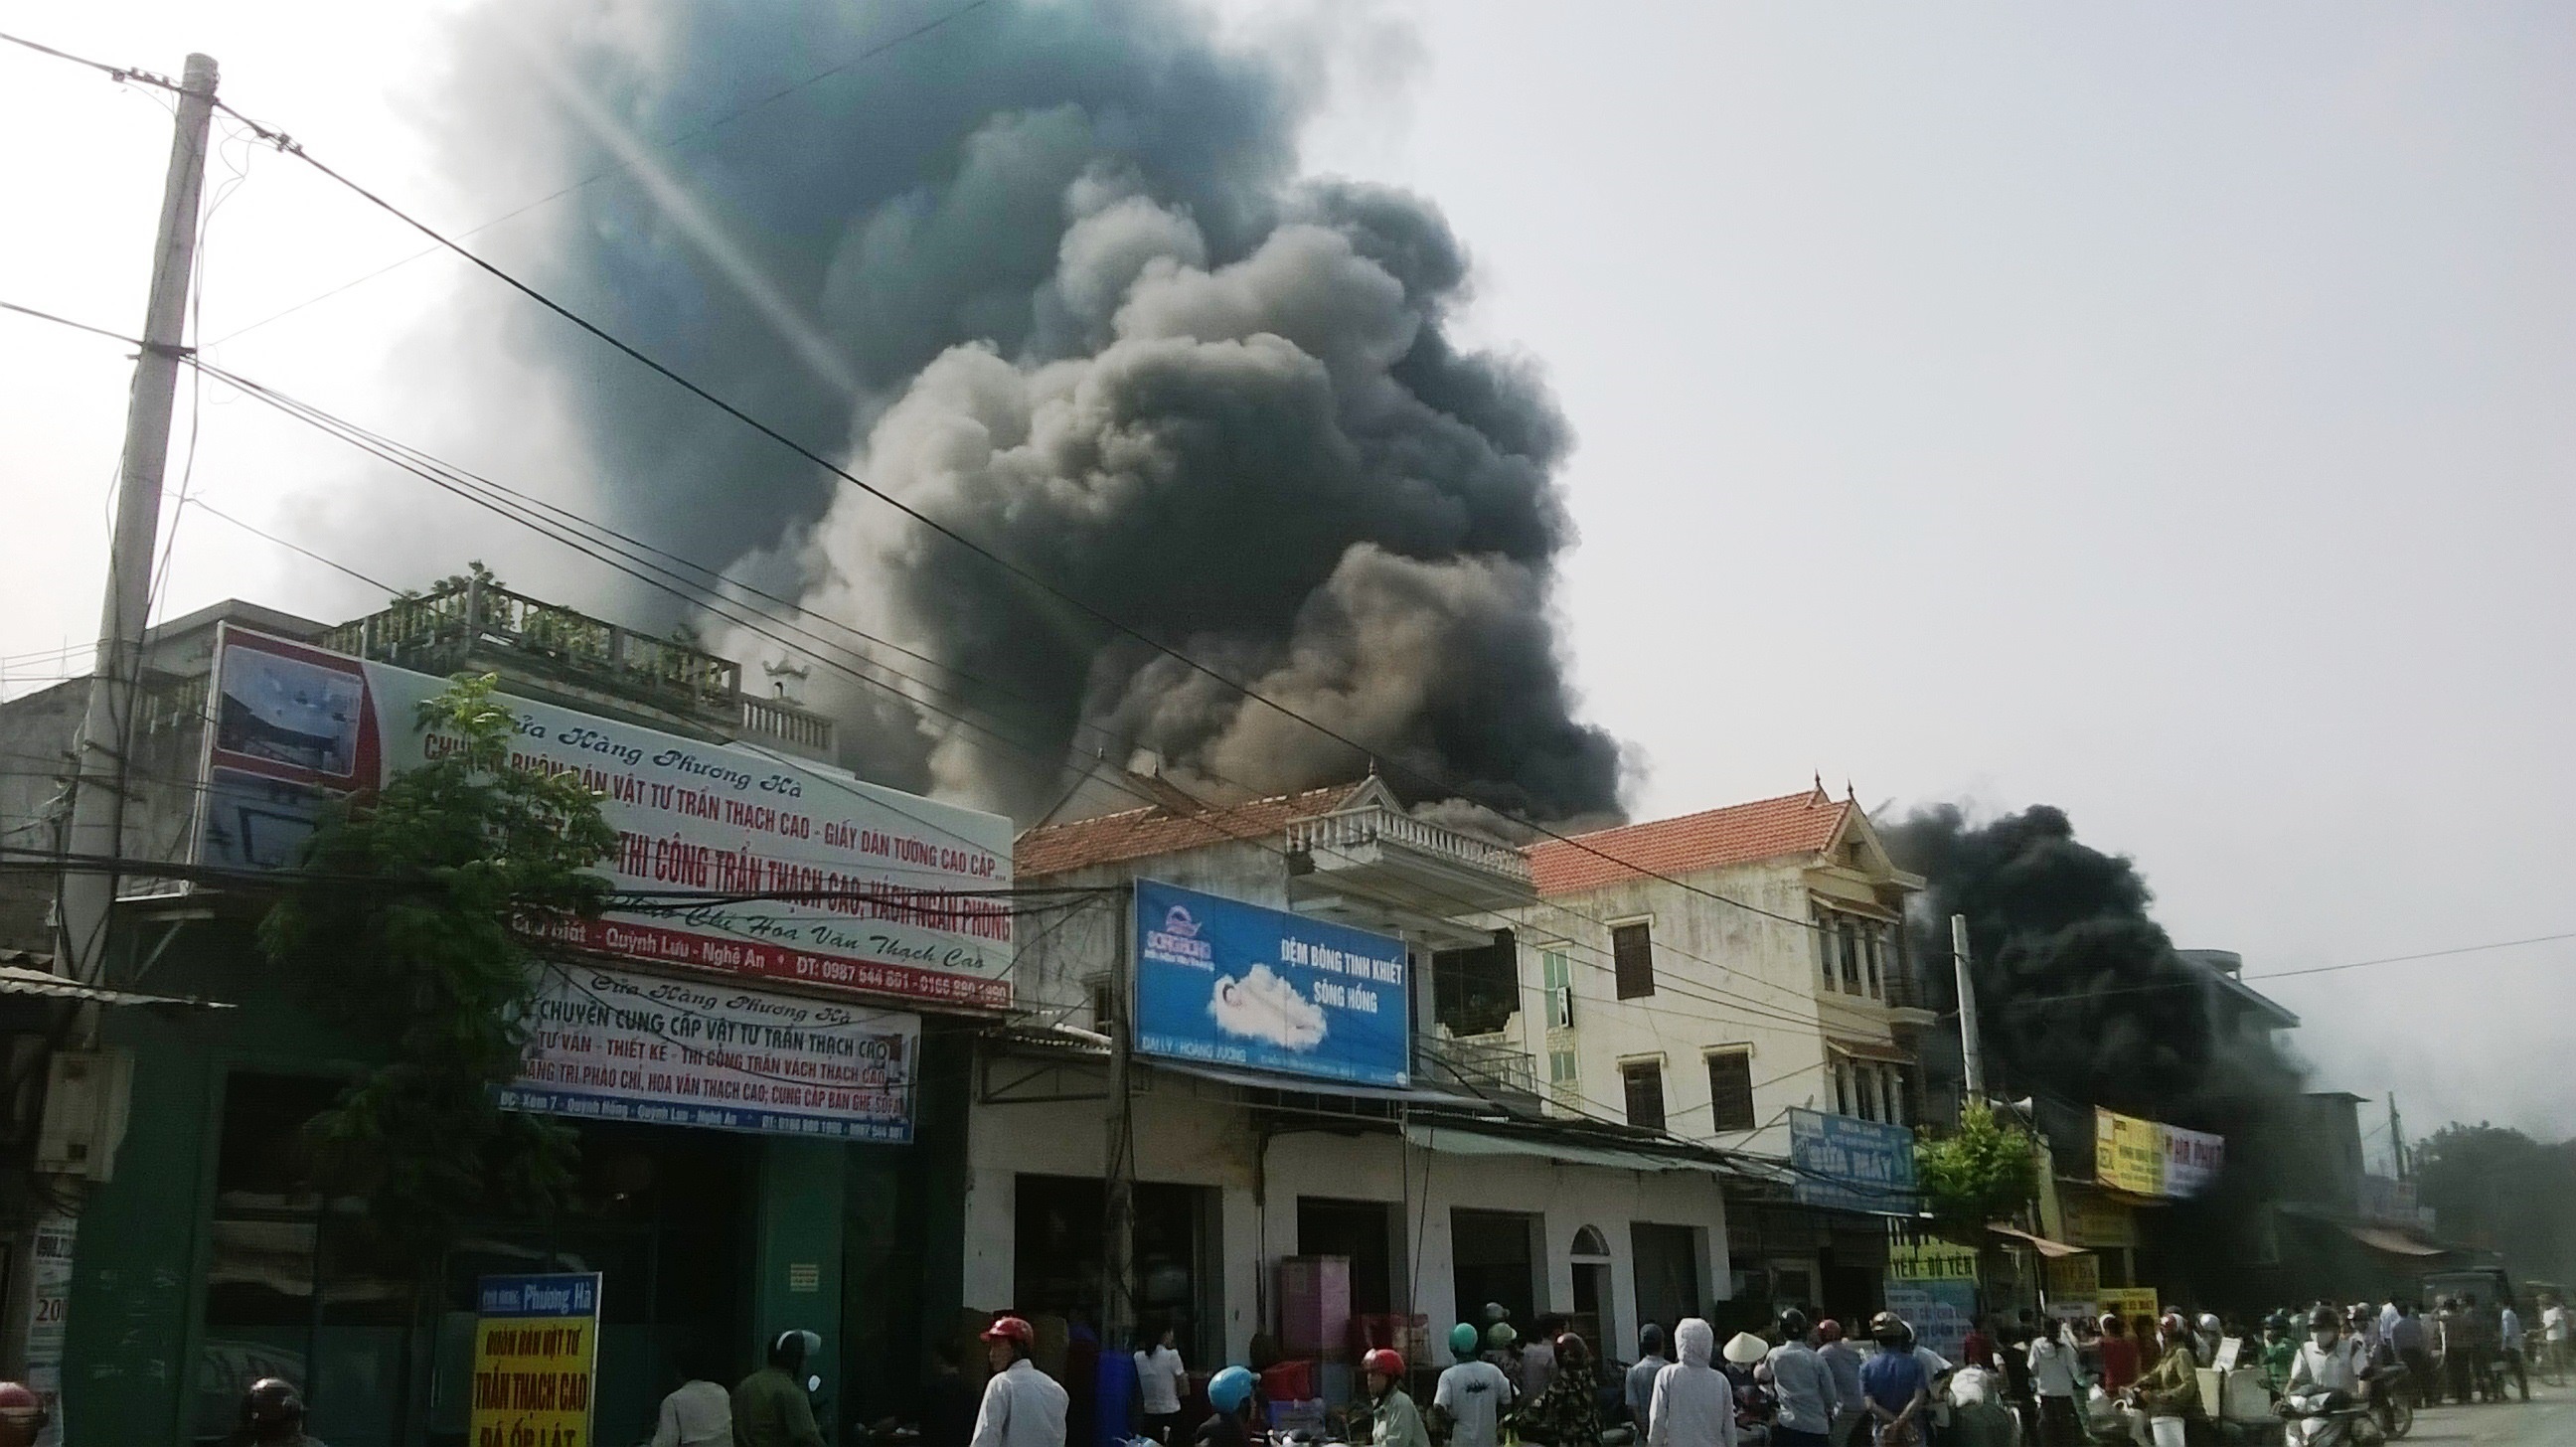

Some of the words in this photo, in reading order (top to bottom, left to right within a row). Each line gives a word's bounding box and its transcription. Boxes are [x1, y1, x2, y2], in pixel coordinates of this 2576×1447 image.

[516, 714, 546, 739] ửa
[559, 727, 644, 766] Hàng
[653, 749, 752, 791] Phương
[760, 773, 803, 798] Hà
[613, 773, 646, 808] VẬT
[651, 783, 674, 810] TƯ
[725, 799, 775, 833] THẠCH
[780, 812, 810, 840] CAO
[825, 819, 857, 851] GIẤY
[861, 829, 890, 858] DÁN
[894, 835, 938, 868] TƯỜNG
[941, 847, 967, 875] CAO
[618, 831, 650, 878] THI
[655, 832, 708, 887] CÔNG
[768, 860, 823, 912] THẠCH
[606, 927, 657, 953] Quỳnh
[703, 942, 741, 970] Nghệ
[745, 953, 765, 968] An
[747, 915, 800, 940] Hoa
[811, 926, 860, 949] Văn
[870, 935, 936, 963] Thạch
[944, 949, 985, 969] Cao
[1281, 936, 1309, 967] ĐỆM
[1310, 943, 1343, 973] BÔNG
[1344, 952, 1370, 979] TINH
[1371, 956, 1402, 985] KHIẾT
[726, 995, 808, 1022] Phương
[816, 1007, 852, 1024] Hà
[1314, 978, 1345, 1008] SÔNG
[809, 1035, 854, 1059] THẠCH
[524, 1283, 572, 1315] Phương
[573, 1281, 592, 1310] Hà
[513, 1371, 558, 1418] THẠCH
[559, 1371, 588, 1412] CAO
